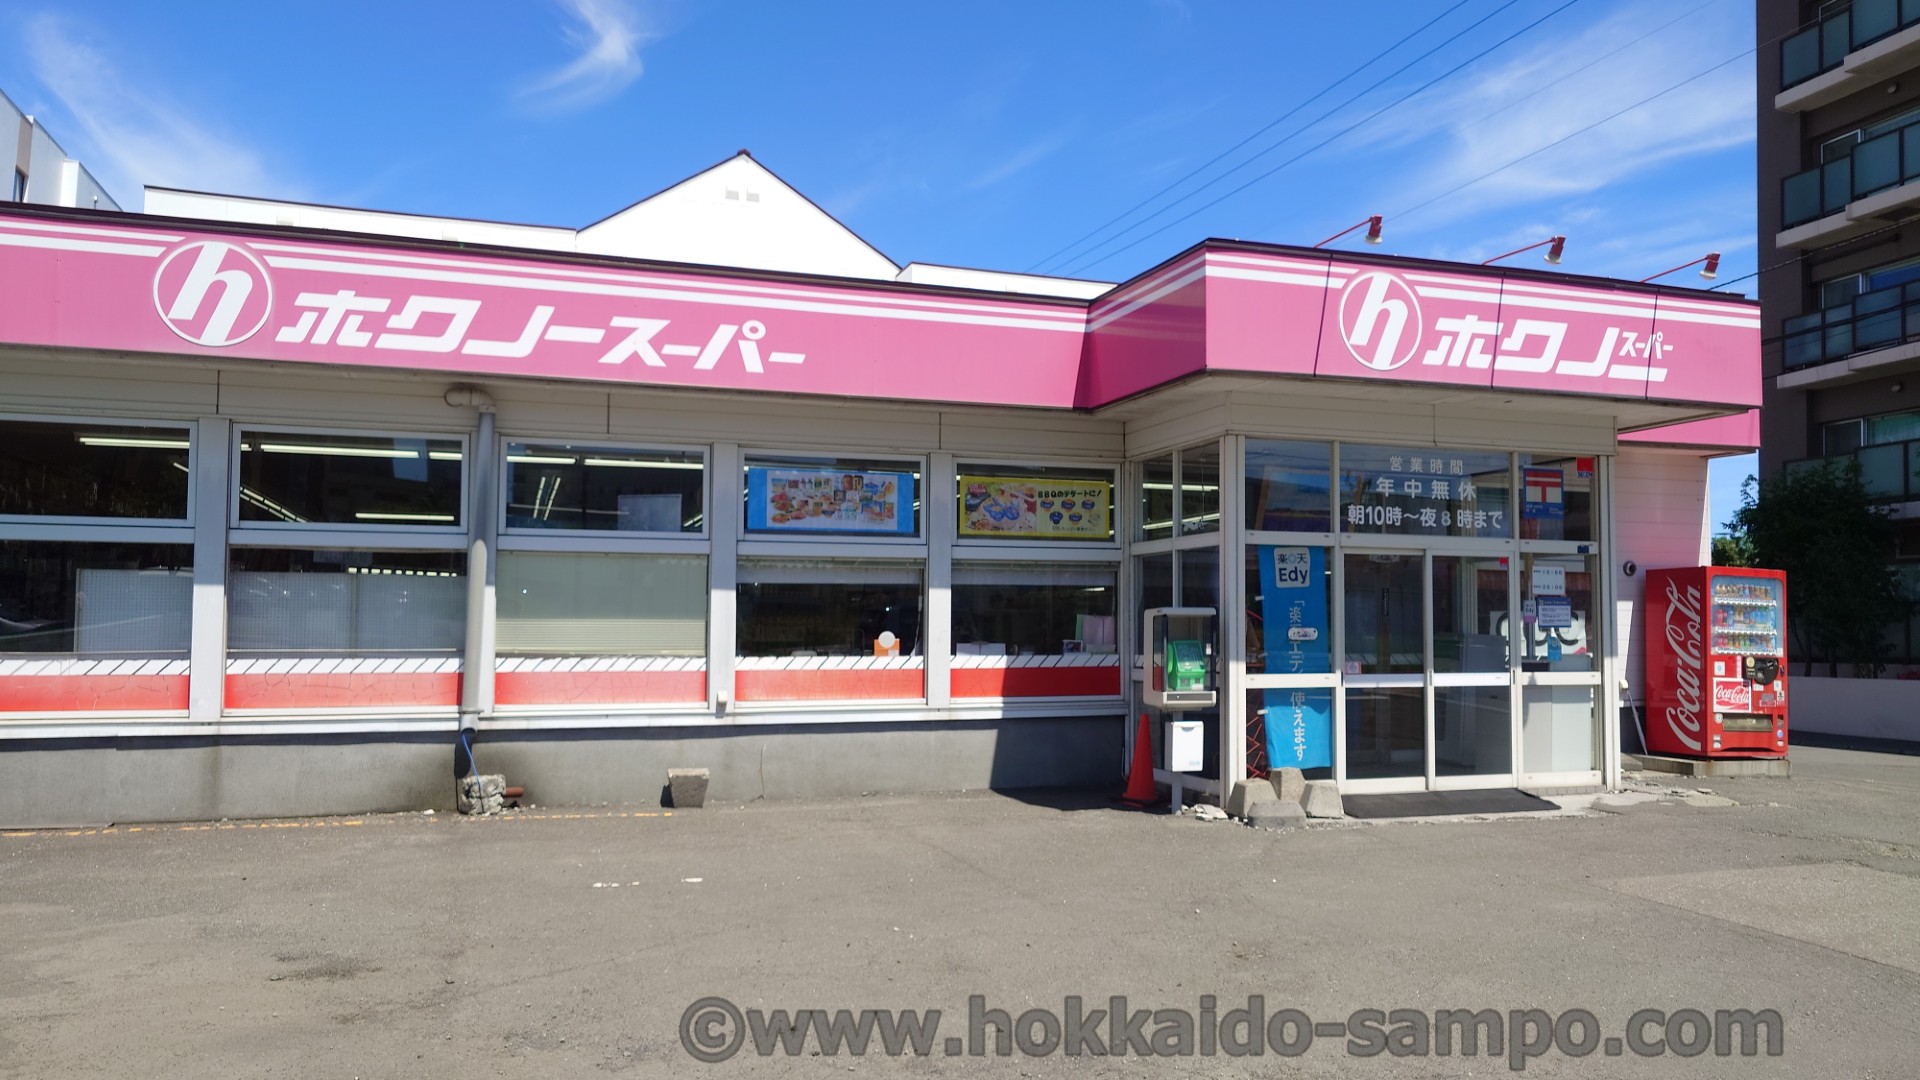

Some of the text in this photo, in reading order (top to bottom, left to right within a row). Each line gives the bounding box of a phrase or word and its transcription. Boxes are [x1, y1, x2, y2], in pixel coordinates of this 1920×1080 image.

[275, 289, 806, 374] ホクノースーパー
[1619, 330, 1674, 360] スーパー
[1389, 456, 1463, 475] 営業時間
[1376, 477, 1477, 501] 年中無休
[1279, 567, 1308, 584] Edy
[1666, 576, 1701, 751] Coca-Cola
